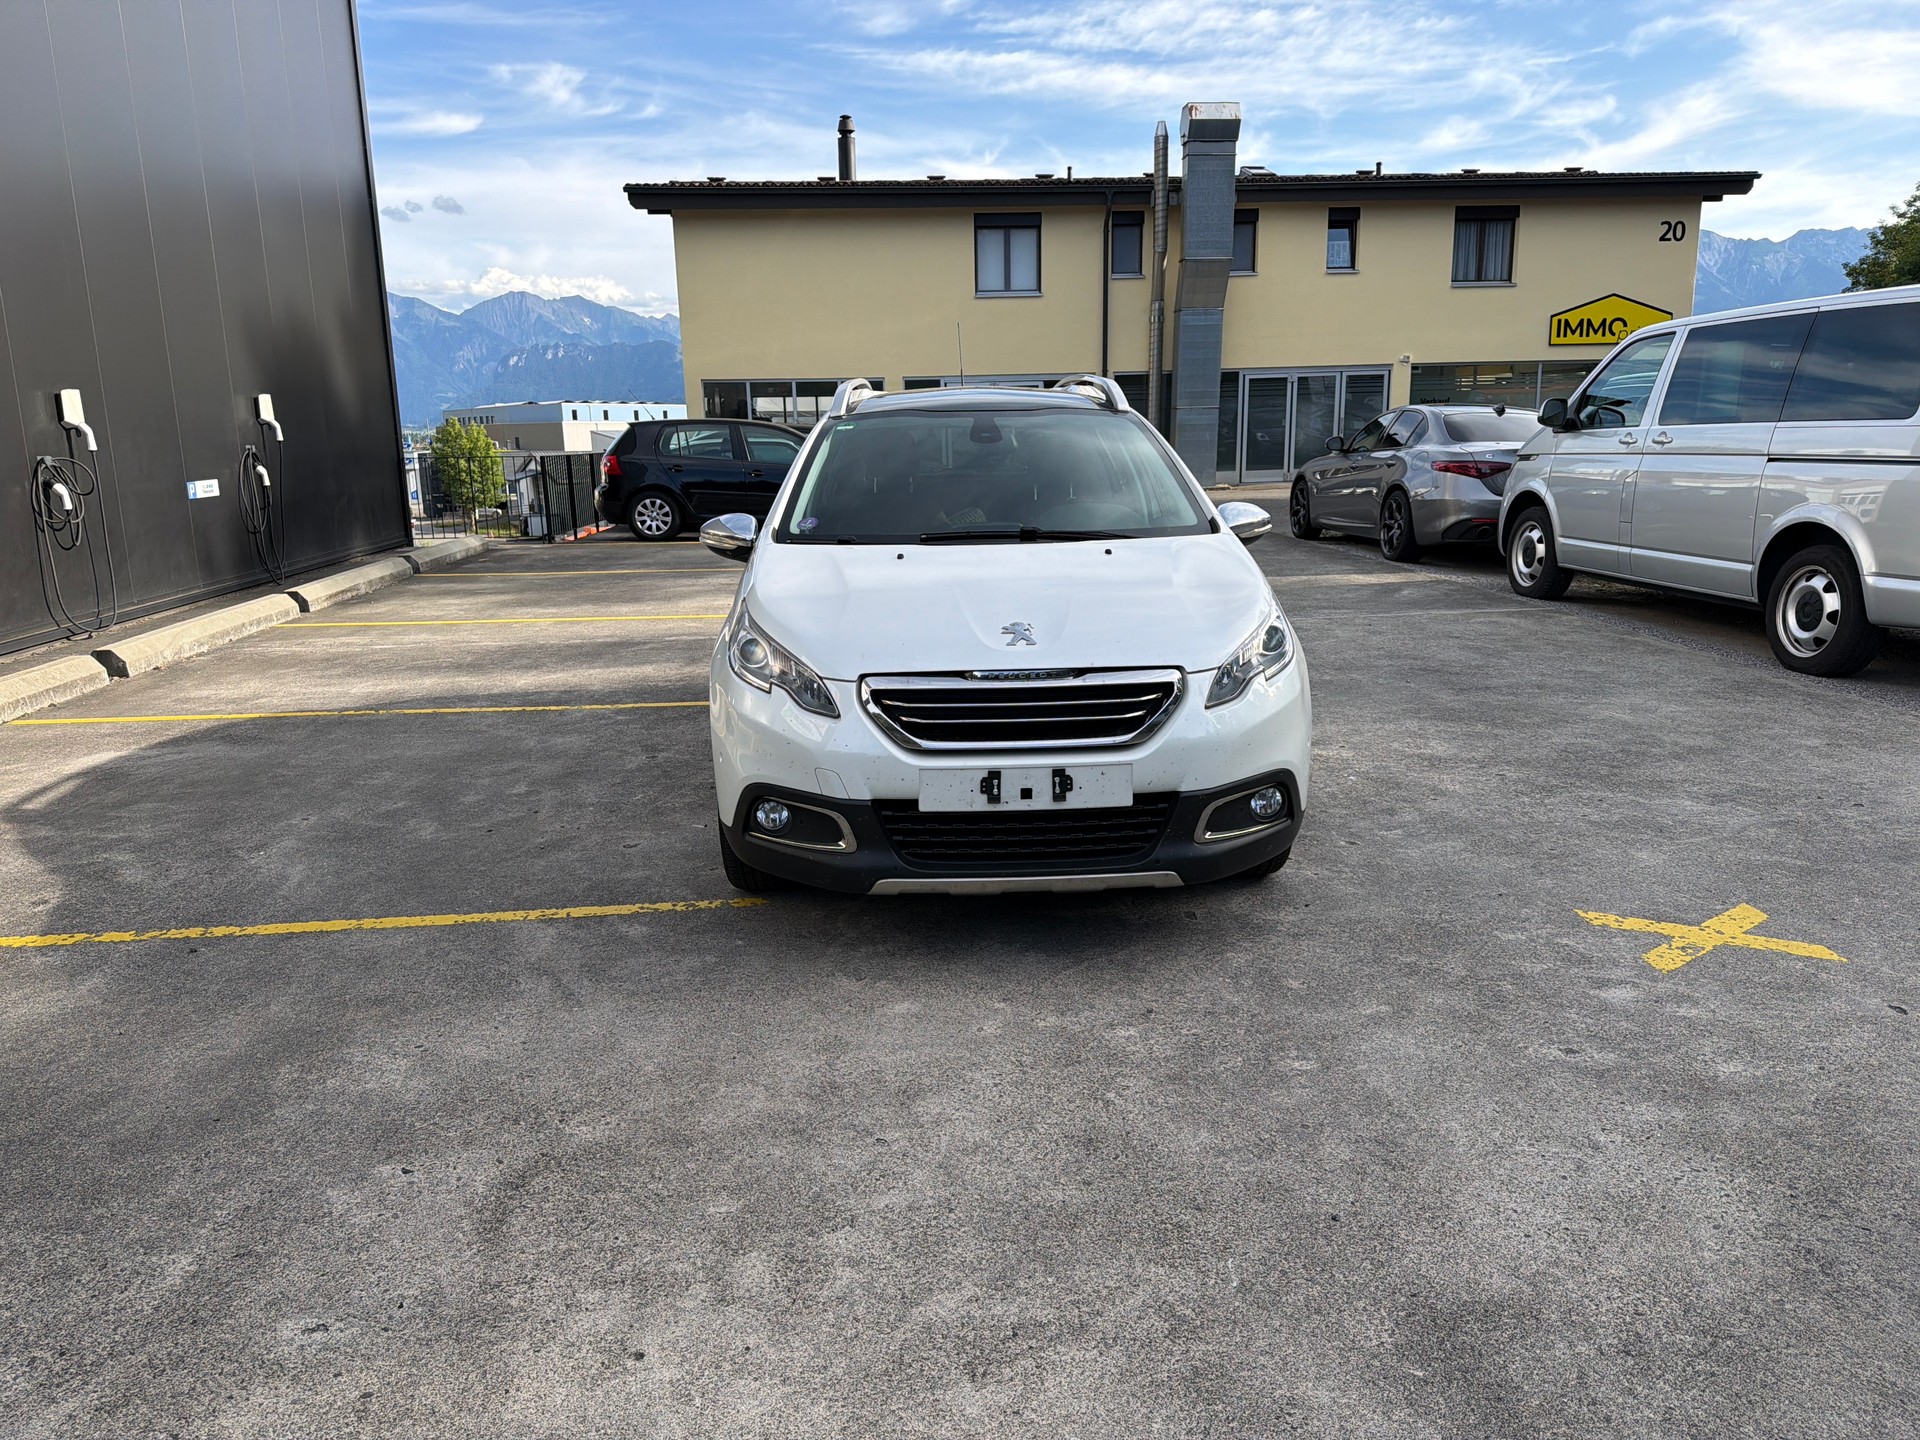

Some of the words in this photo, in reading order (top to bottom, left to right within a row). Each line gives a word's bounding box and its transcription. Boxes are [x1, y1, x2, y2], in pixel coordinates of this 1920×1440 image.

[1659, 220, 1686, 242] 20
[1556, 317, 1628, 338] IMMO
[189, 484, 196, 498] P
[987, 671, 1058, 679] PEUGEOT
